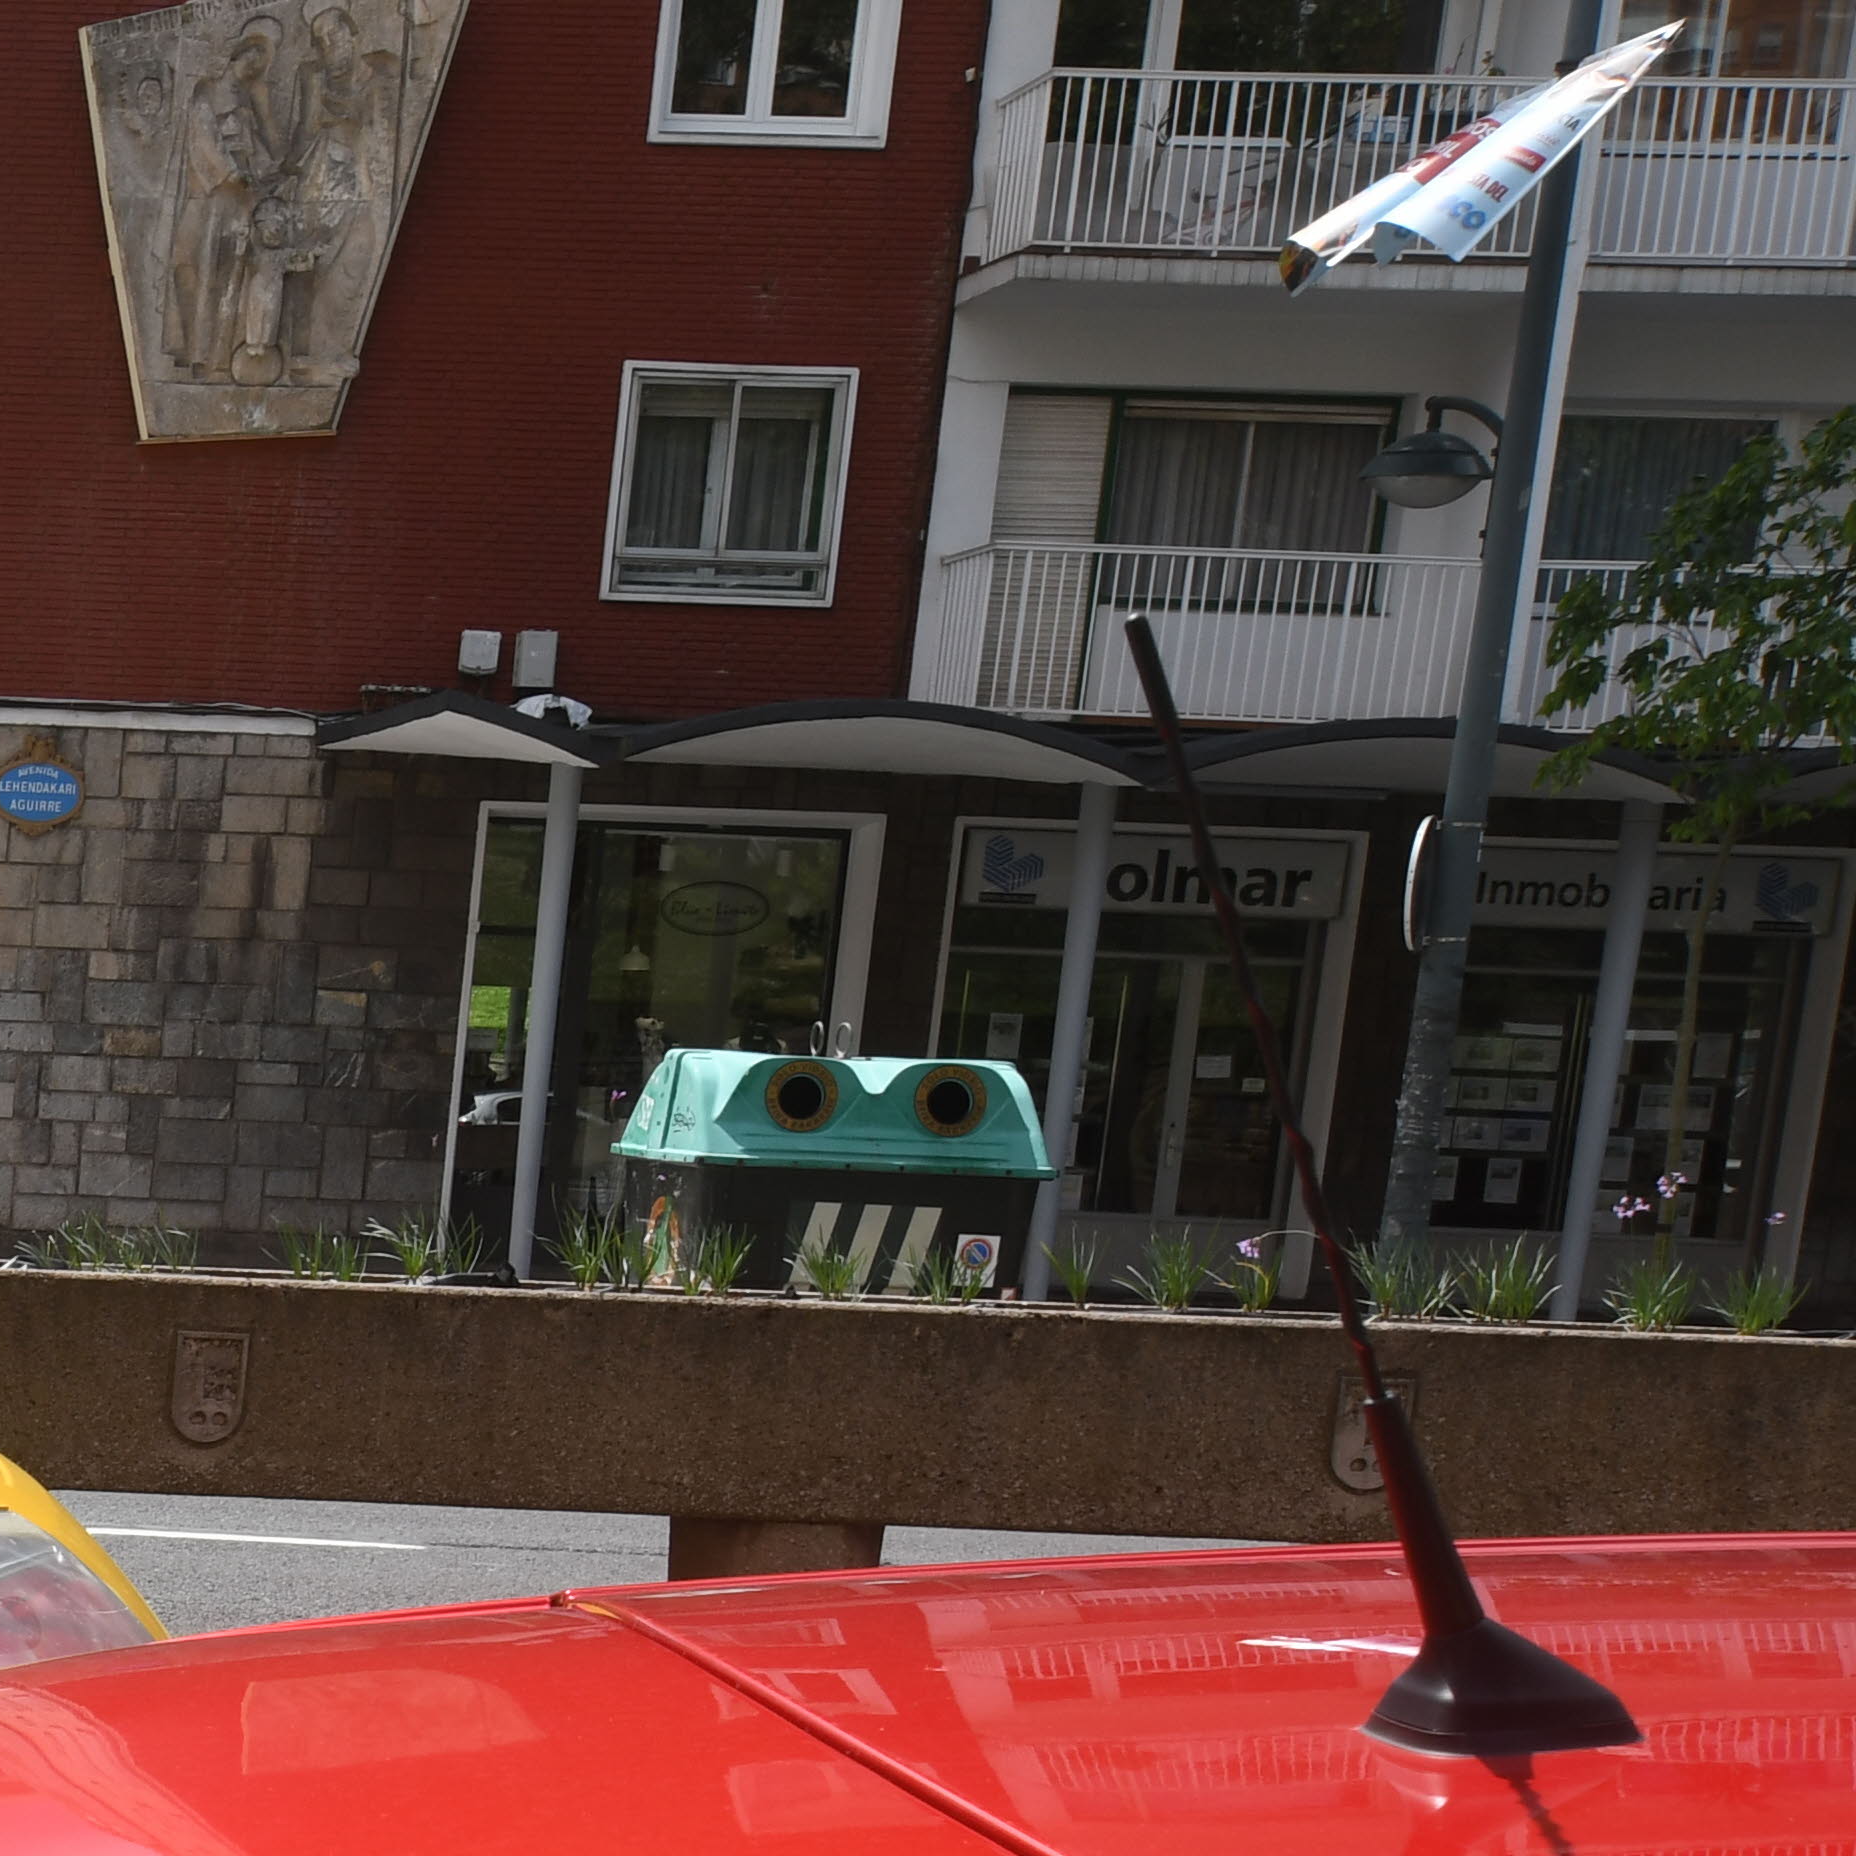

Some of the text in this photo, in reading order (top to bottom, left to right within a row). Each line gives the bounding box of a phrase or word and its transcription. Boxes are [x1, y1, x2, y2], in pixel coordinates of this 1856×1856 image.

[17, 766, 59, 779] AVENIDA
[0, 781, 76, 795] LEHENDAKARI
[9, 799, 62, 812] AGUIRRE
[1106, 849, 1312, 908] olmar
